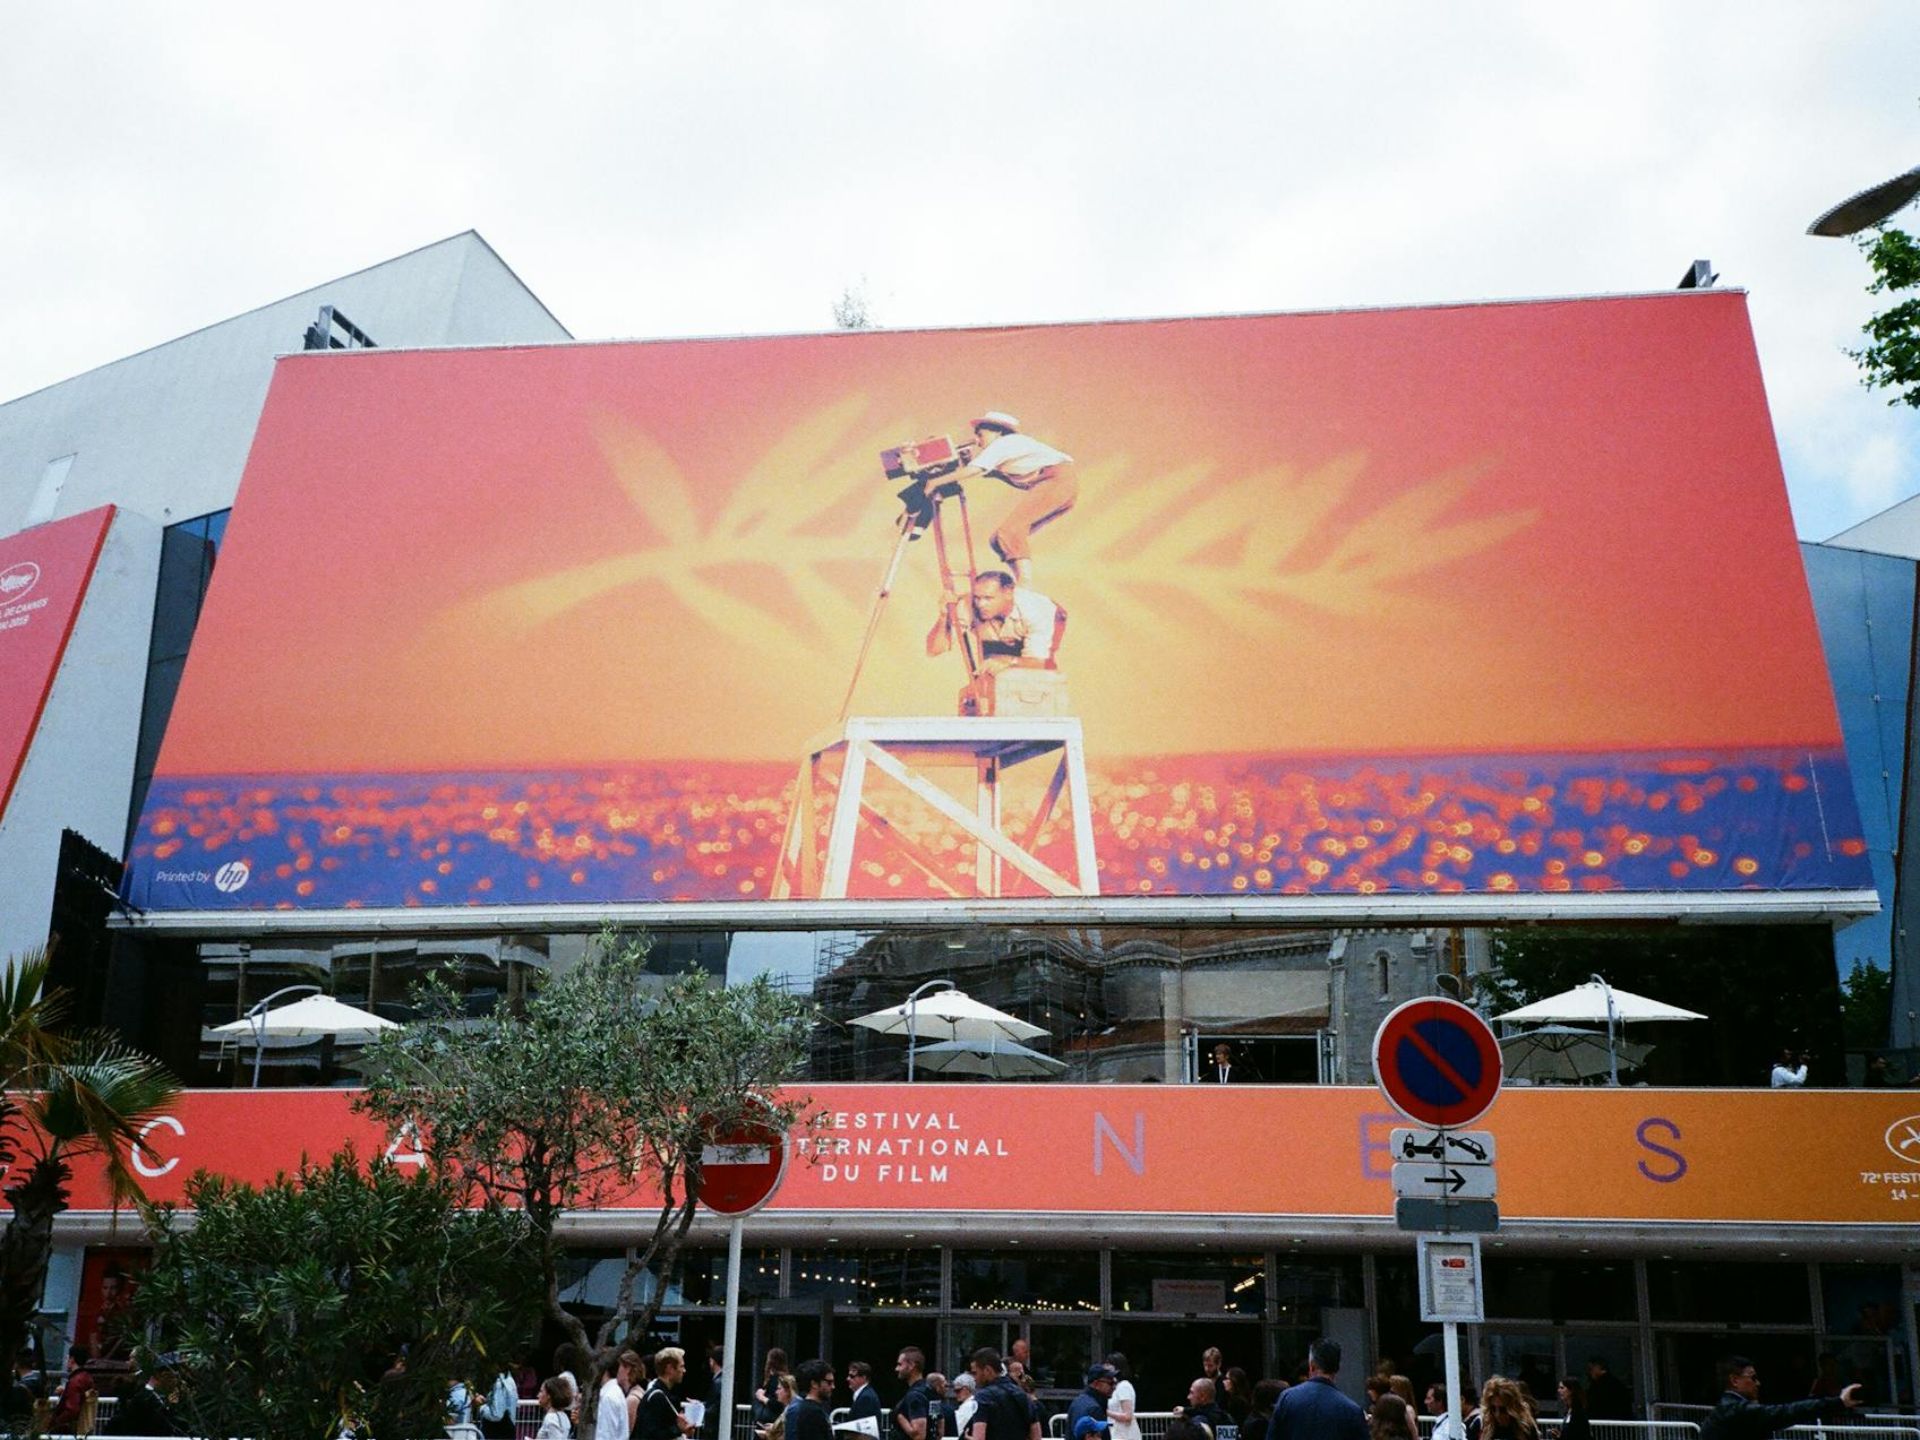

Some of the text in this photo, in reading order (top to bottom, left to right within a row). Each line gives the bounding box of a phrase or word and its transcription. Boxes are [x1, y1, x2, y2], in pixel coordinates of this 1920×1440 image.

[156, 862, 248, 893] Printed by hp
[796, 1138, 1009, 1156] TERNATIONAL
[1636, 1117, 1688, 1183] S
[823, 1164, 949, 1182] DU FILM
[1891, 1188, 1908, 1201] 14
